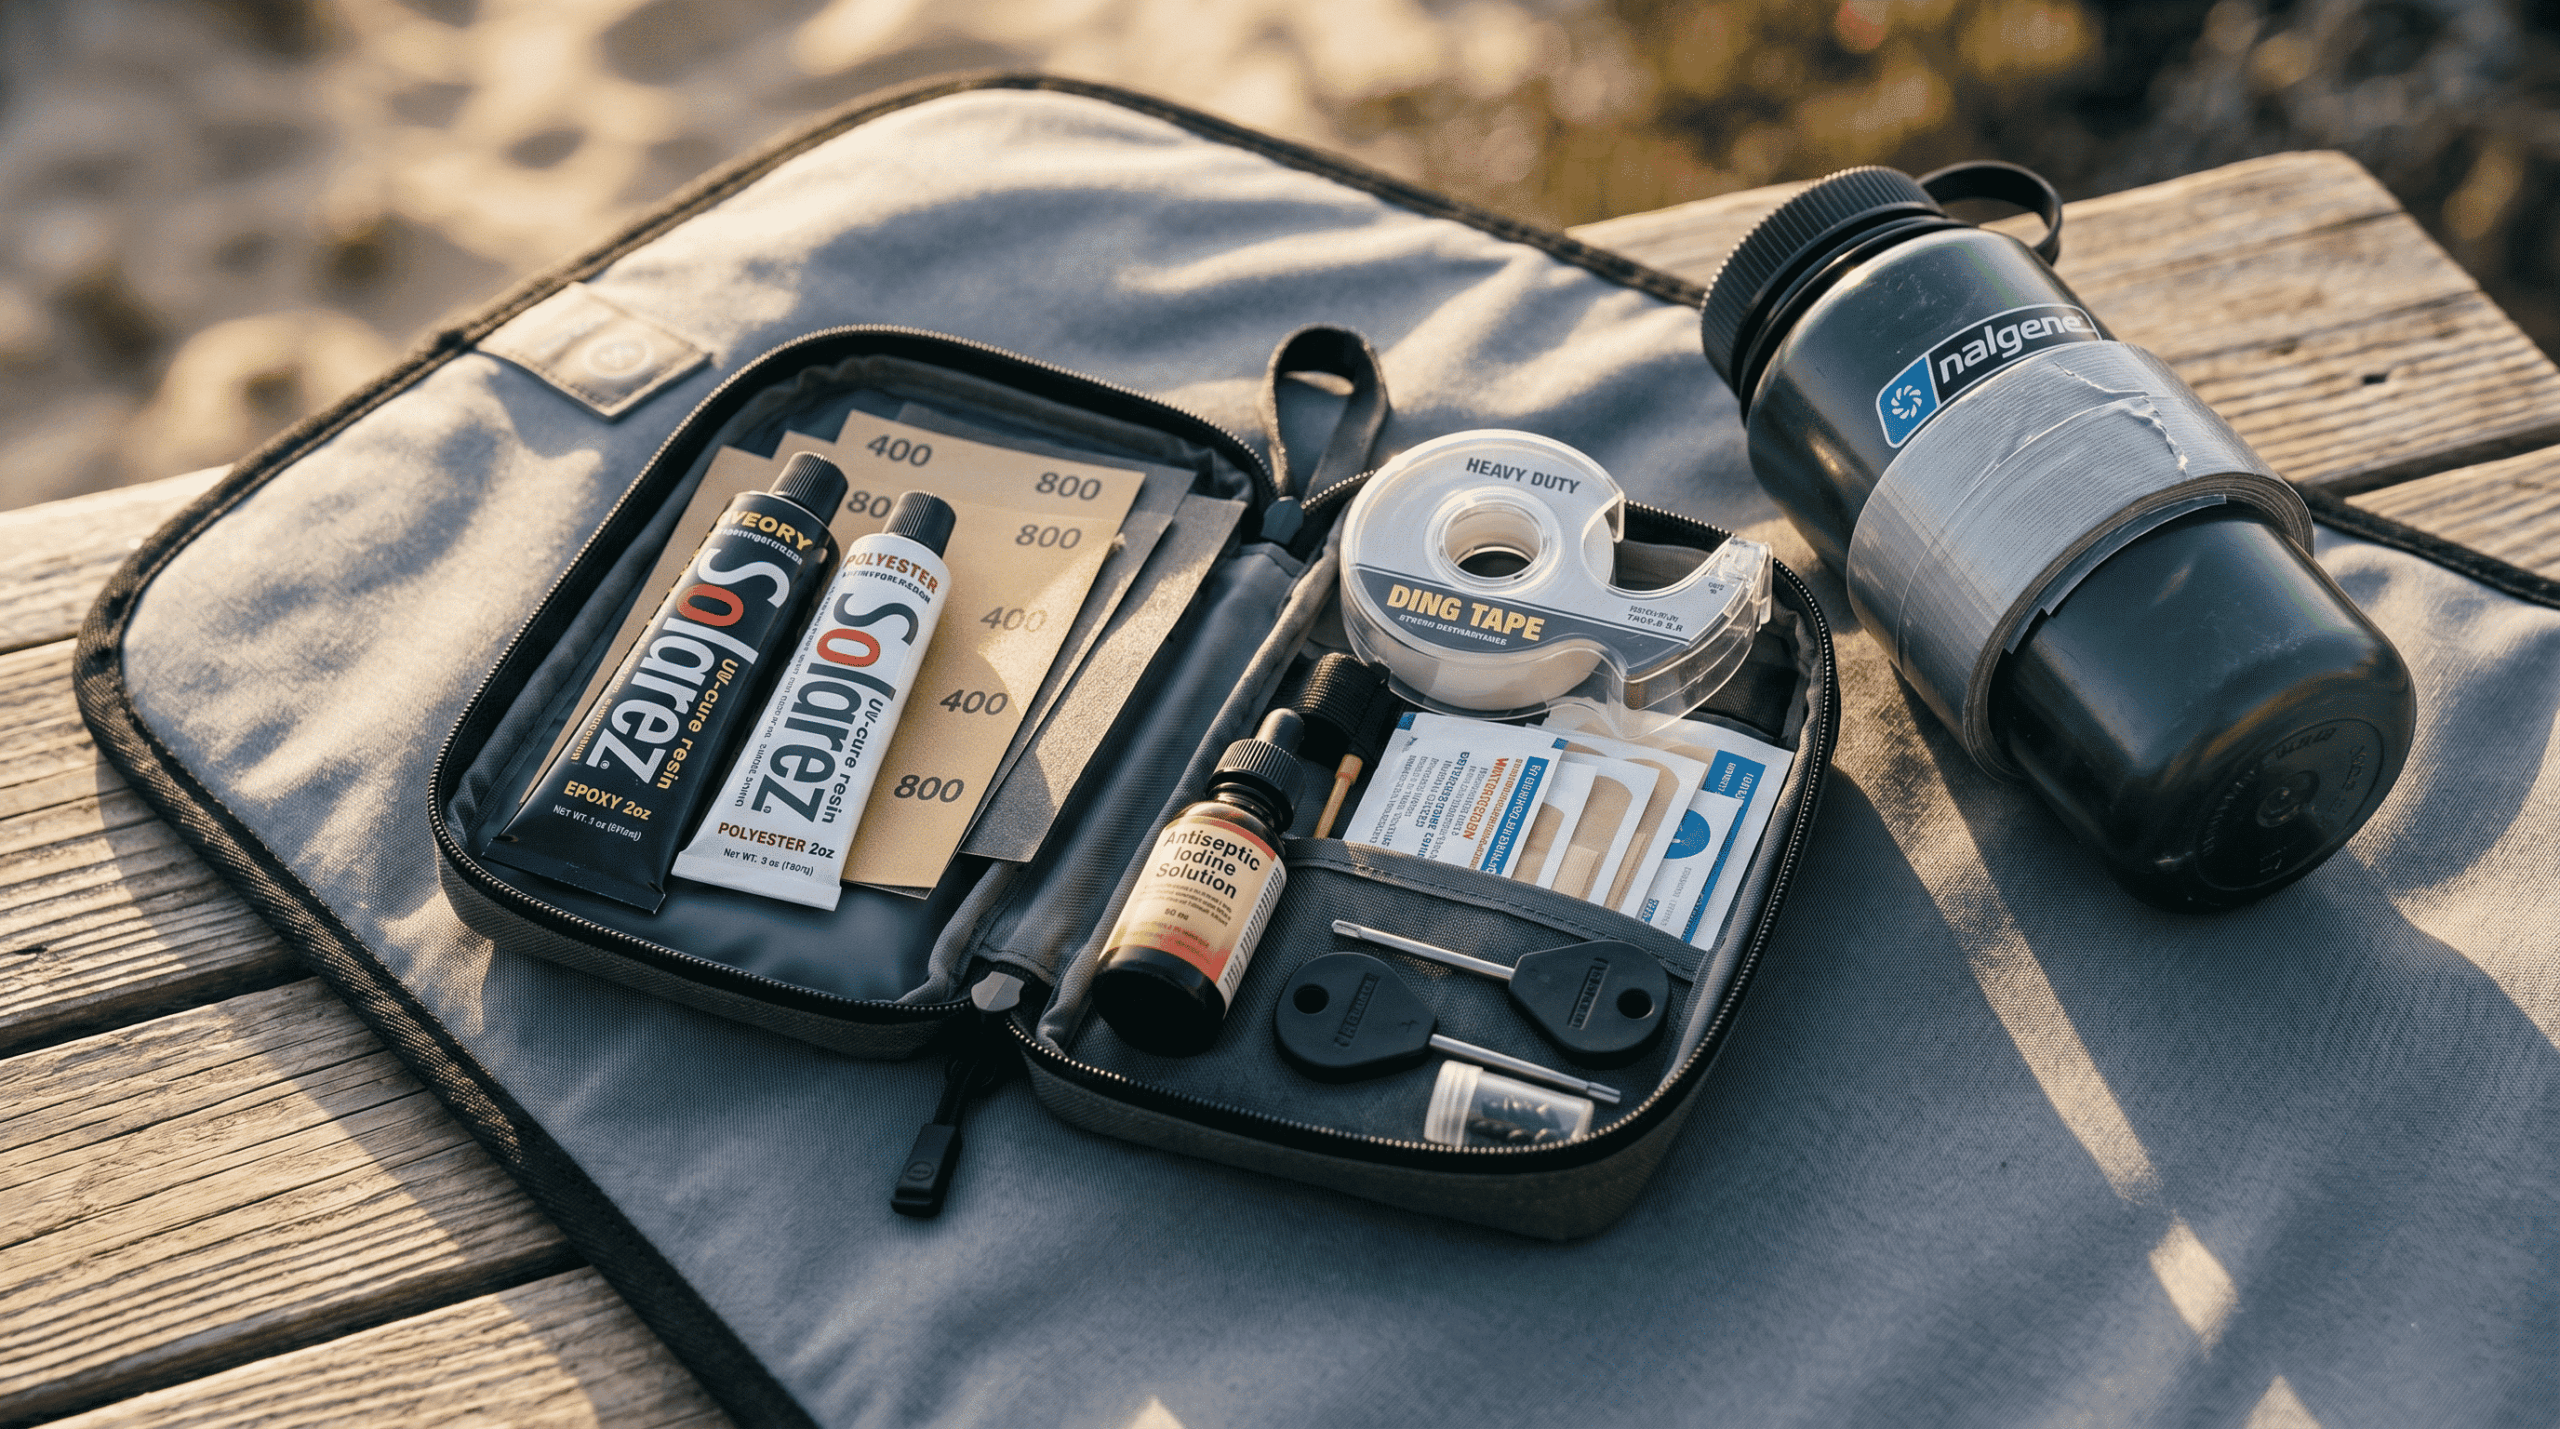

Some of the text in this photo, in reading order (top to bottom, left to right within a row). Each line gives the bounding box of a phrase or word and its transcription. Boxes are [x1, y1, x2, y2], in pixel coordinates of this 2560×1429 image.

[1938, 315, 2088, 384] nalgene
[866, 434, 932, 467] 400
[1035, 472, 1102, 501] 800
[1465, 457, 1581, 494] HEAVY DUTY
[1015, 524, 1082, 550] 800
[842, 552, 938, 594] POLYESTER
[980, 606, 1048, 633] 400
[1386, 584, 1462, 621] DING
[1470, 602, 1545, 641] TAPE
[585, 547, 790, 784] Solarez
[751, 592, 919, 823] Solarez
[939, 689, 1009, 715] 400
[656, 737, 694, 790] resin
[563, 780, 652, 821] EPOXY 2oz
[821, 773, 851, 824] resin
[893, 774, 965, 803] 800
[718, 822, 835, 859] POLYESTER 2oz
[1163, 830, 1261, 872] Antiseptic
[1174, 846, 1237, 877] Iodine
[1156, 862, 1238, 899] Solution
